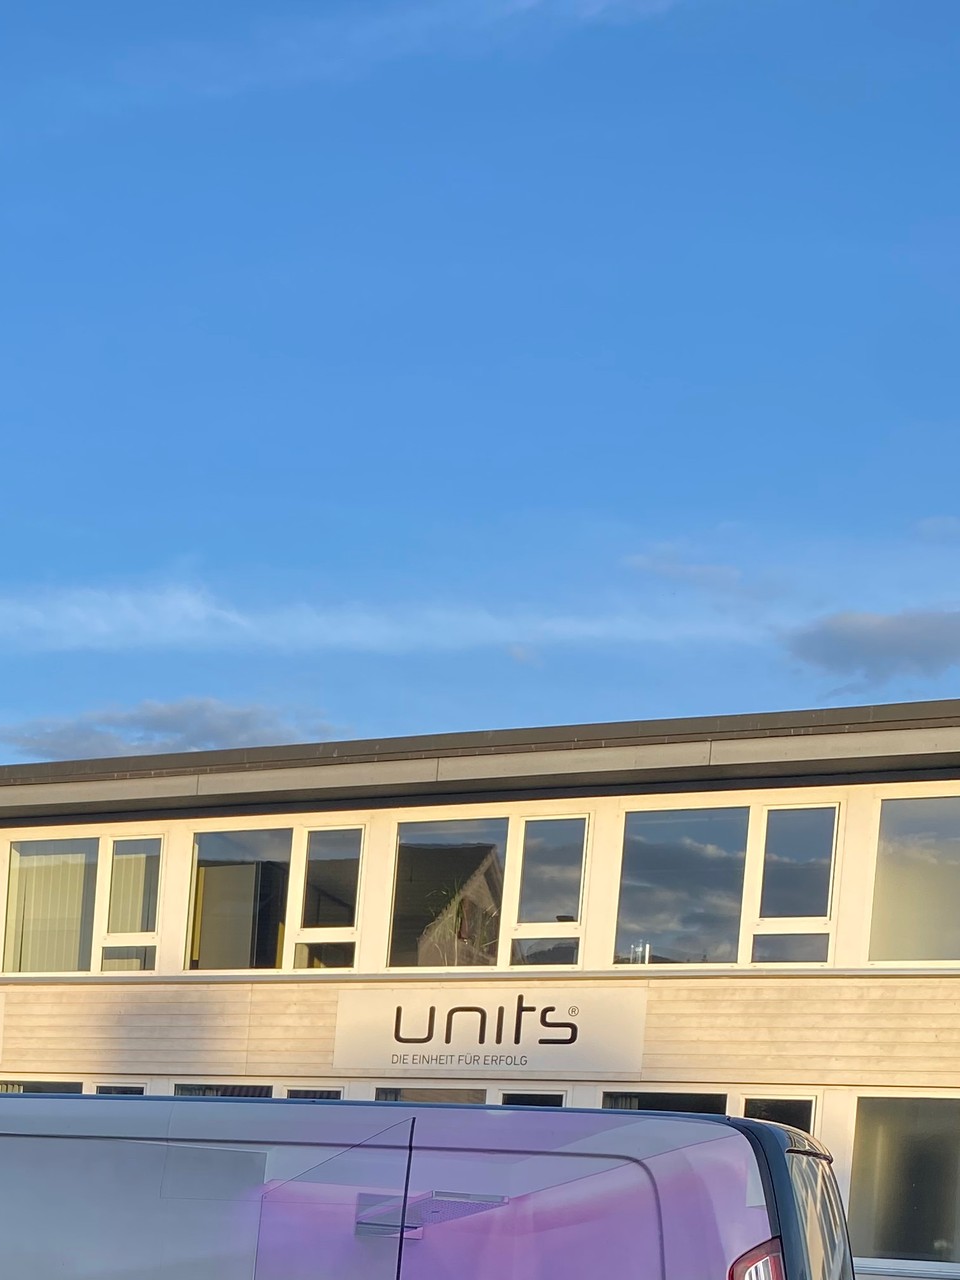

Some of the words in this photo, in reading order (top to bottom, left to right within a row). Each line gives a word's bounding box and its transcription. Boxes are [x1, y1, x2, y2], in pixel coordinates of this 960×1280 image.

[391, 1054, 409, 1065] DIE
[411, 1054, 455, 1065] EINHEIT
[458, 1053, 481, 1066] FÜR
[483, 1055, 528, 1066] ERFOLG
